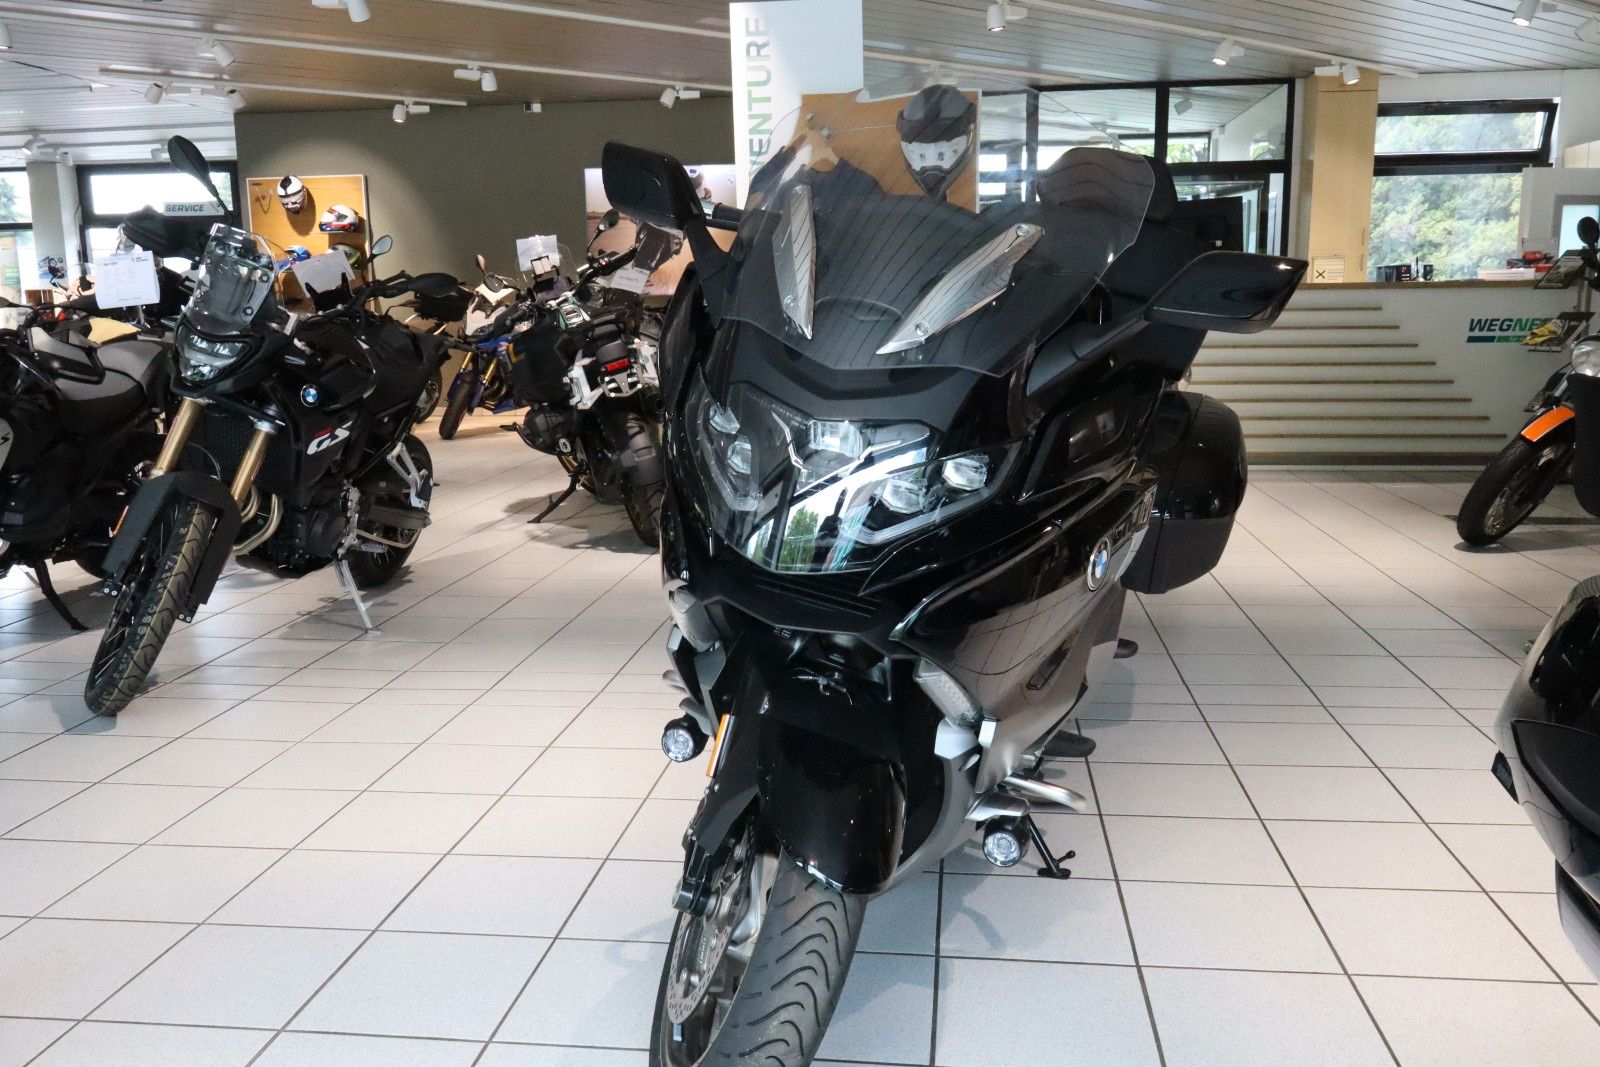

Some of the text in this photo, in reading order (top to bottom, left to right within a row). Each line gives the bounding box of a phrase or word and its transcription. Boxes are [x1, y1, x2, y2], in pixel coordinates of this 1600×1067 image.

[165, 204, 205, 213] SERVICE
[1468, 318, 1552, 333] WEGNE
[306, 420, 354, 455] GS
